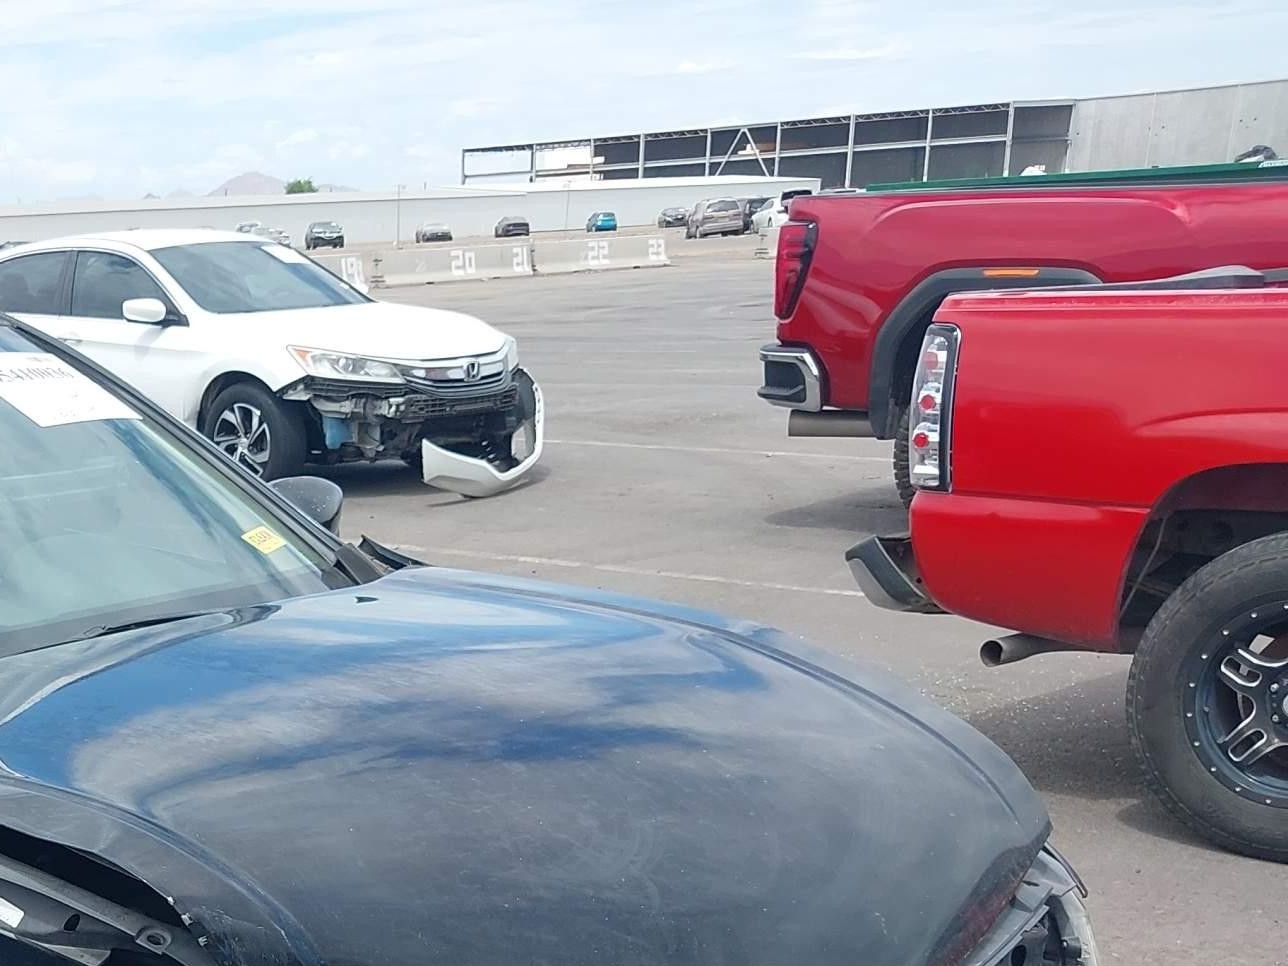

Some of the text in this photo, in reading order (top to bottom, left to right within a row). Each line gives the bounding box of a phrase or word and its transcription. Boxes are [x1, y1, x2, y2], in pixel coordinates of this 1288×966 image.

[451, 249, 476, 275] 20
[512, 247, 529, 272] 21
[586, 240, 611, 265] 22
